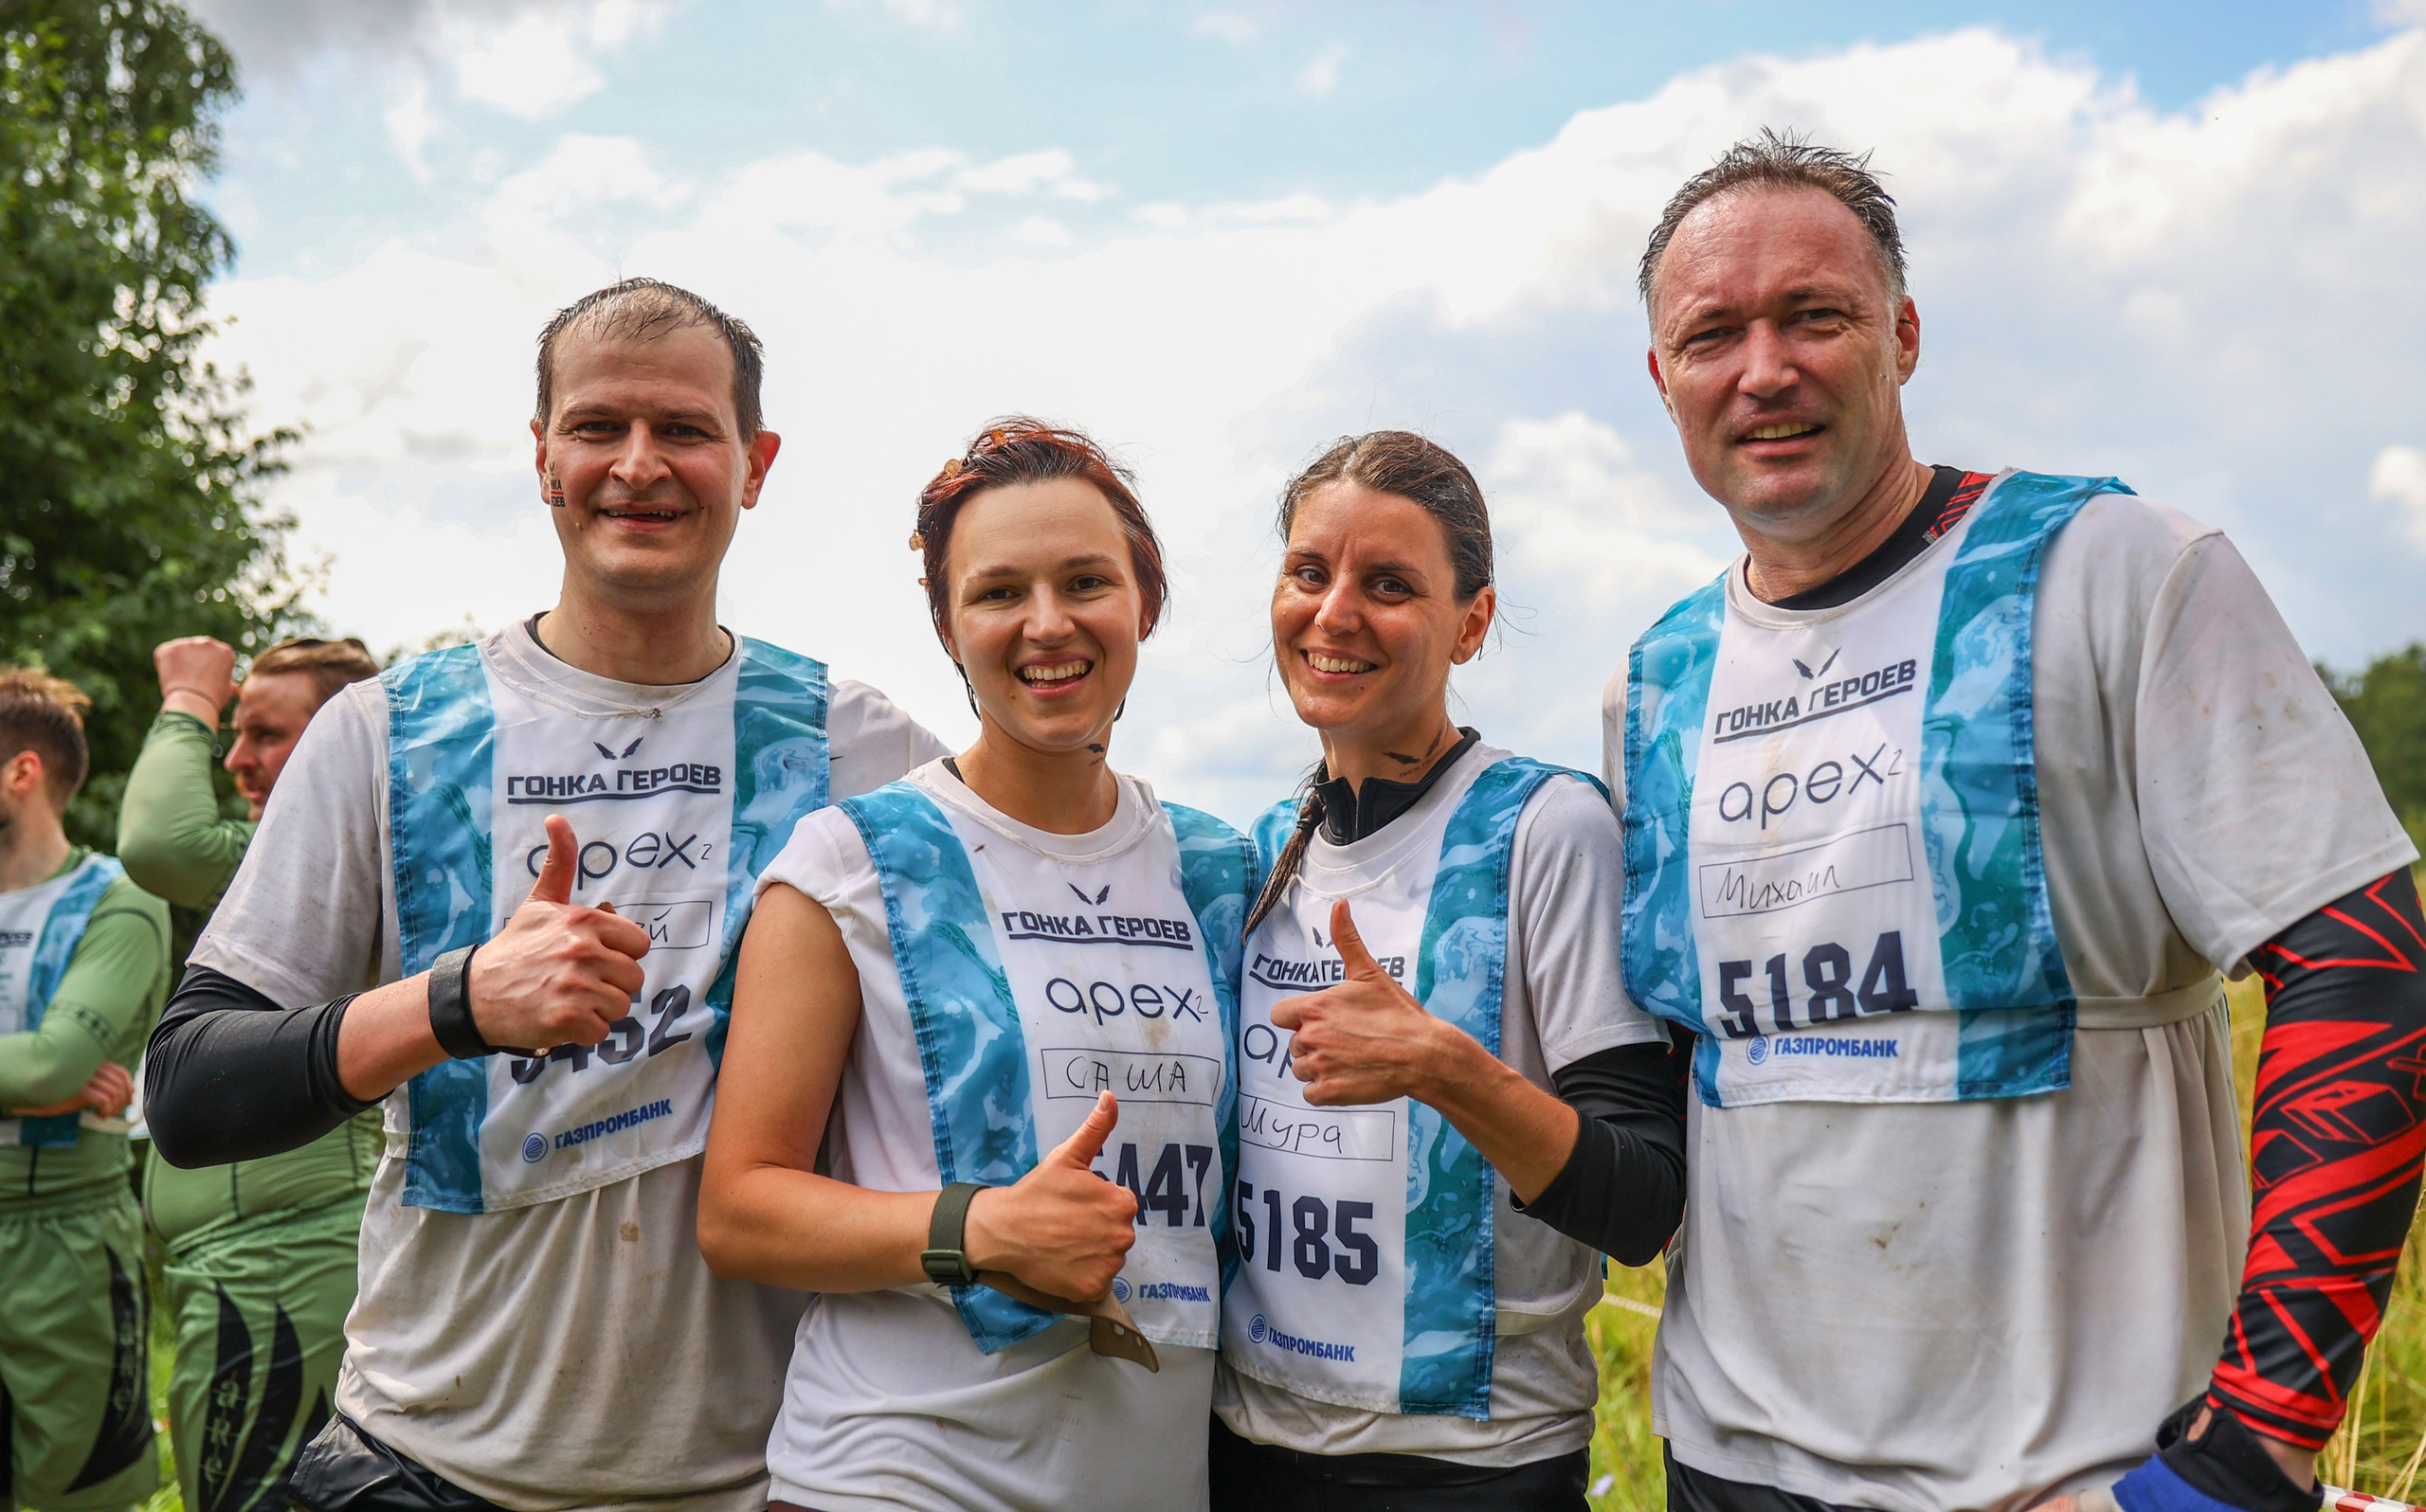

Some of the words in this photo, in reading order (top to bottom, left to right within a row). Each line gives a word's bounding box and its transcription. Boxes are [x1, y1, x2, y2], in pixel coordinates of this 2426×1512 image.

[1714, 695, 1800, 735] ГОНКА
[1807, 658, 1916, 712] ГЕРОЕВ
[507, 772, 607, 797] ГОНКА
[617, 763, 721, 791] ГЕРОЕВ
[1715, 865, 1841, 909] Михаил
[1001, 910, 1095, 937] ГОНКА
[1097, 914, 1191, 942] ГЕРОЕВ
[1252, 952, 1319, 982] ГОНКА
[1718, 930, 1919, 1038] 5184
[1774, 1036, 1899, 1058] ГАЗПРОМБАНК
[1066, 1055, 1186, 1093] САША
[554, 1098, 673, 1149] ГАЗПРОМБАНК
[1237, 1179, 1379, 1286] 5185
[1138, 1283, 1211, 1304] ГАЗПРОМБАНК
[1268, 1326, 1356, 1362] ГАЗПРОМБАНК
